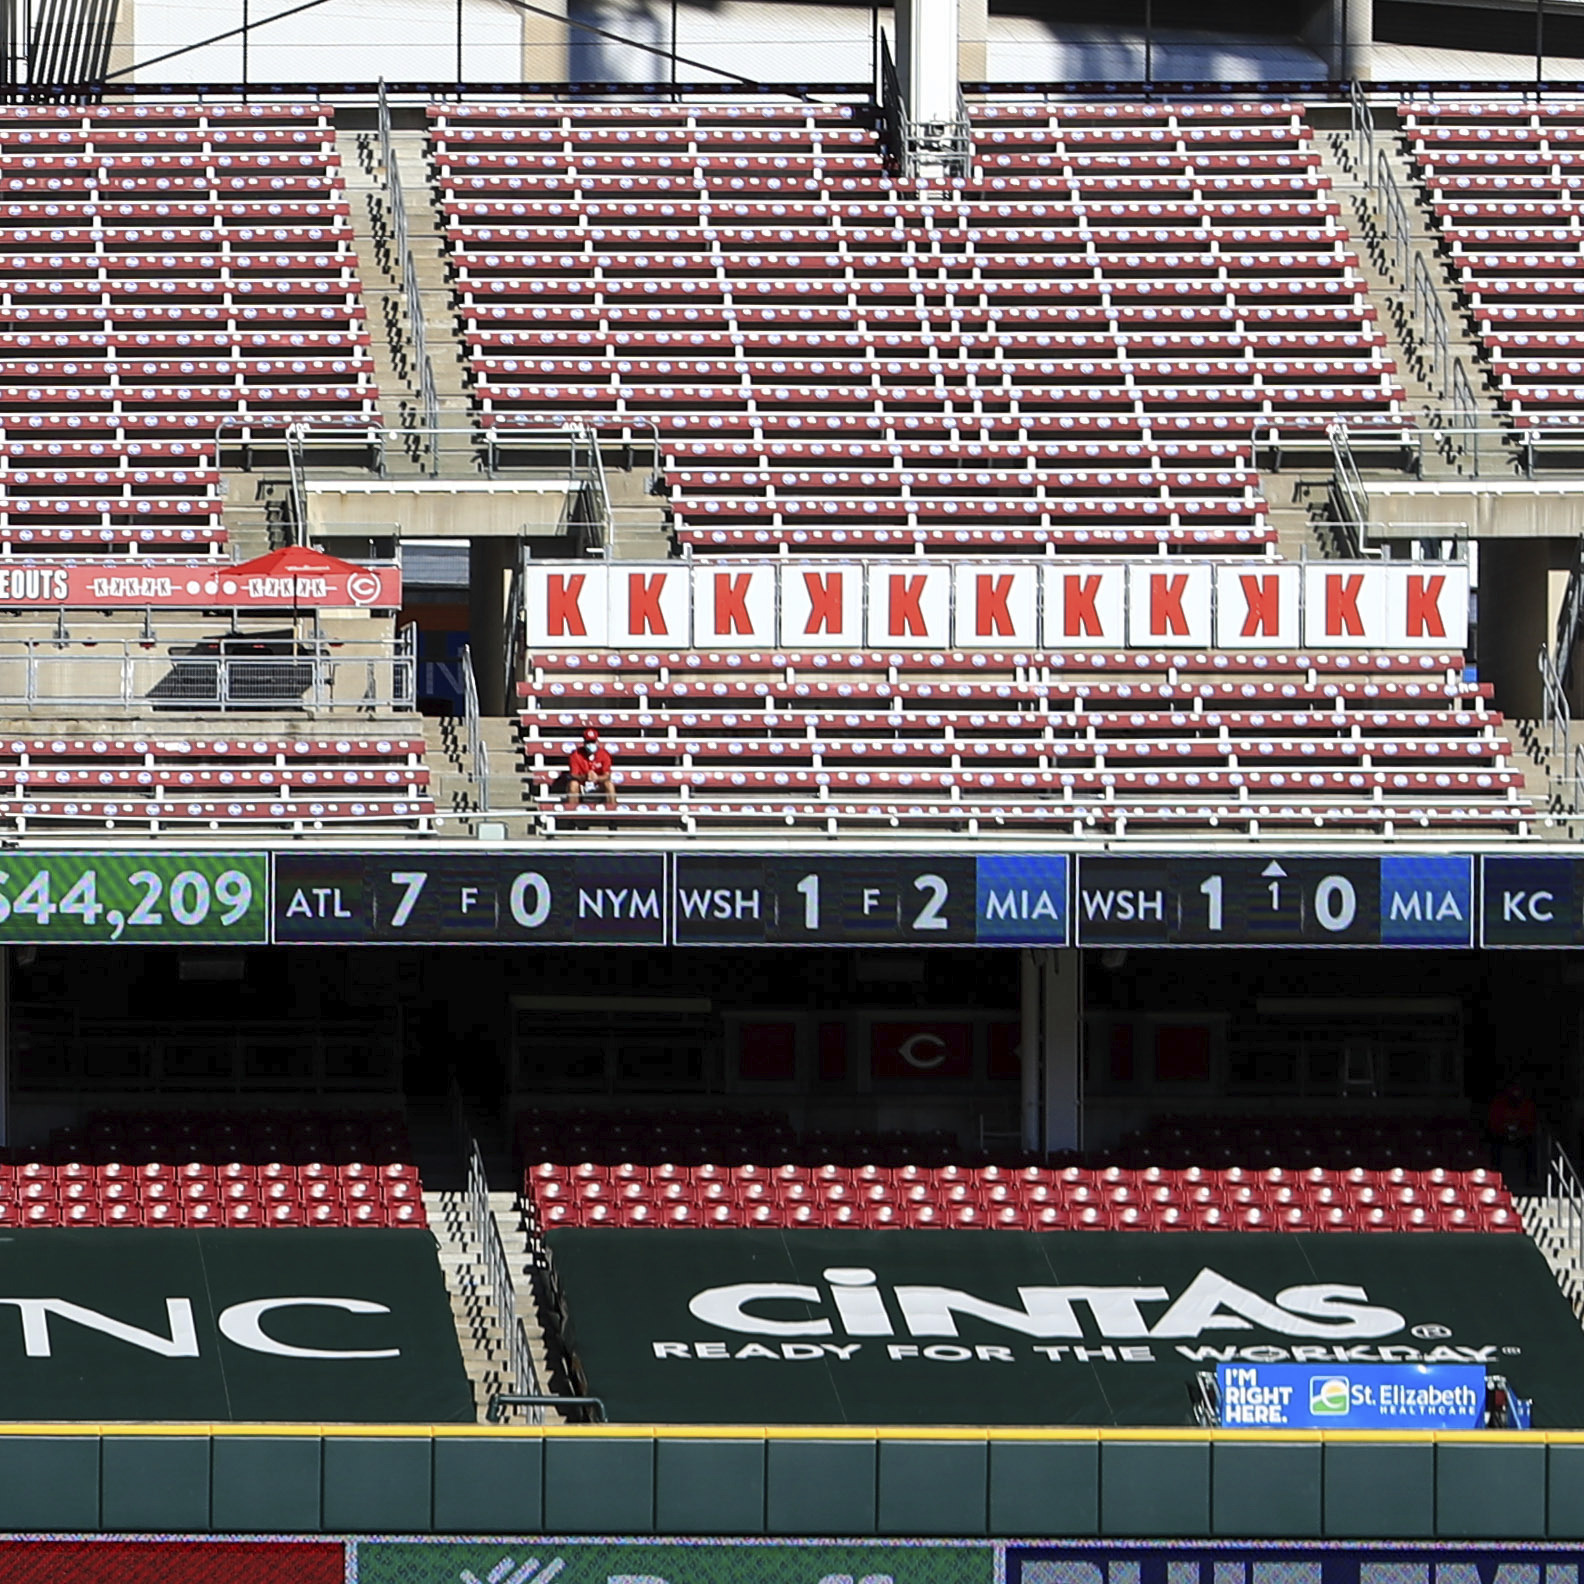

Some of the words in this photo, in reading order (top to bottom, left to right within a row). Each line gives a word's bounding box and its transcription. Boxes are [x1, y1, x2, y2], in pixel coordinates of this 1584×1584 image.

[546, 573, 587, 637] K
[628, 573, 669, 637] K
[714, 573, 755, 637] K
[888, 573, 929, 637] K
[974, 573, 1017, 637] K
[1063, 573, 1105, 637] K
[1150, 573, 1191, 637] K
[1324, 573, 1365, 637] K
[1406, 573, 1447, 637] K
[286, 887, 352, 919] ATL
[389, 872, 427, 927] 7
[461, 889, 478, 914] F
[509, 872, 551, 927] 0
[578, 888, 661, 919] NYM
[679, 890, 761, 920] WSH
[796, 875, 819, 929] 1
[862, 891, 879, 914] F
[912, 875, 949, 929] 2
[985, 890, 1059, 921] MIA
[1081, 890, 1164, 921] WSH
[1200, 876, 1223, 930] 1
[1267, 884, 1280, 912] 1
[1313, 875, 1356, 930] 0
[1388, 890, 1462, 921] MIA
[1502, 892, 1554, 922] KC
[653, 1341, 862, 1361] READY
[888, 1343, 1016, 1363] FOR
[1032, 1344, 1155, 1363] THE
[1175, 1345, 1499, 1363] WORKDAY
[1224, 1368, 1258, 1387] I'M
[1224, 1387, 1293, 1405] RIGHT
[1351, 1385, 1376, 1407] St.
[1379, 1385, 1476, 1407] Elizabeth
[1224, 1406, 1288, 1423] HERE.
[1379, 1407, 1476, 1416] HEALTHCARE
